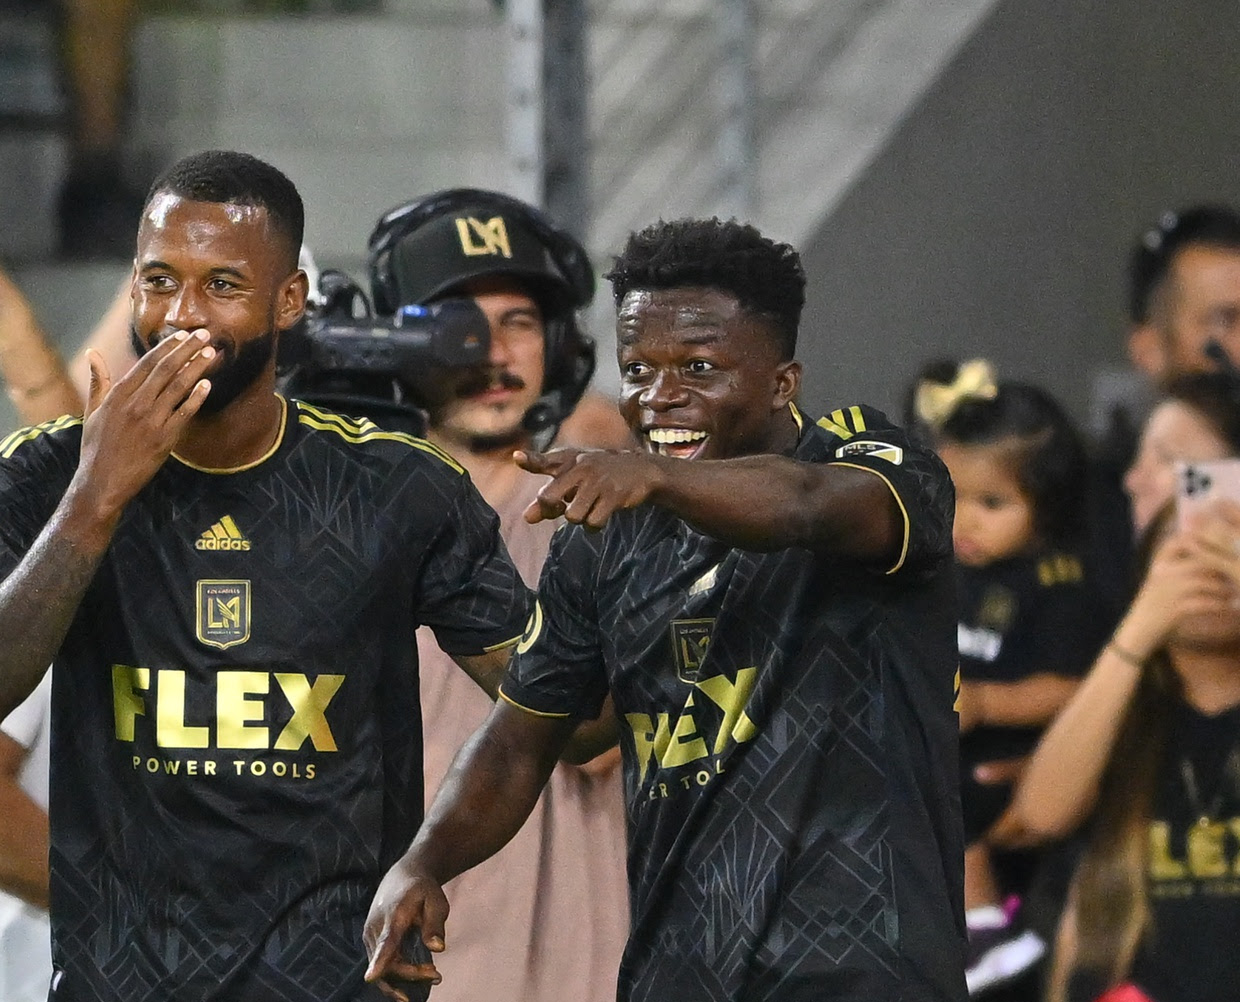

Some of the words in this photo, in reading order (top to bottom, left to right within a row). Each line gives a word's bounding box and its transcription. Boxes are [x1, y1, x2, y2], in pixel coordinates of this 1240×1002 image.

[195, 537, 251, 551] adidas
[111, 664, 346, 752] FLEX
[133, 756, 217, 776] POWER
[233, 760, 316, 780] TOOLS
